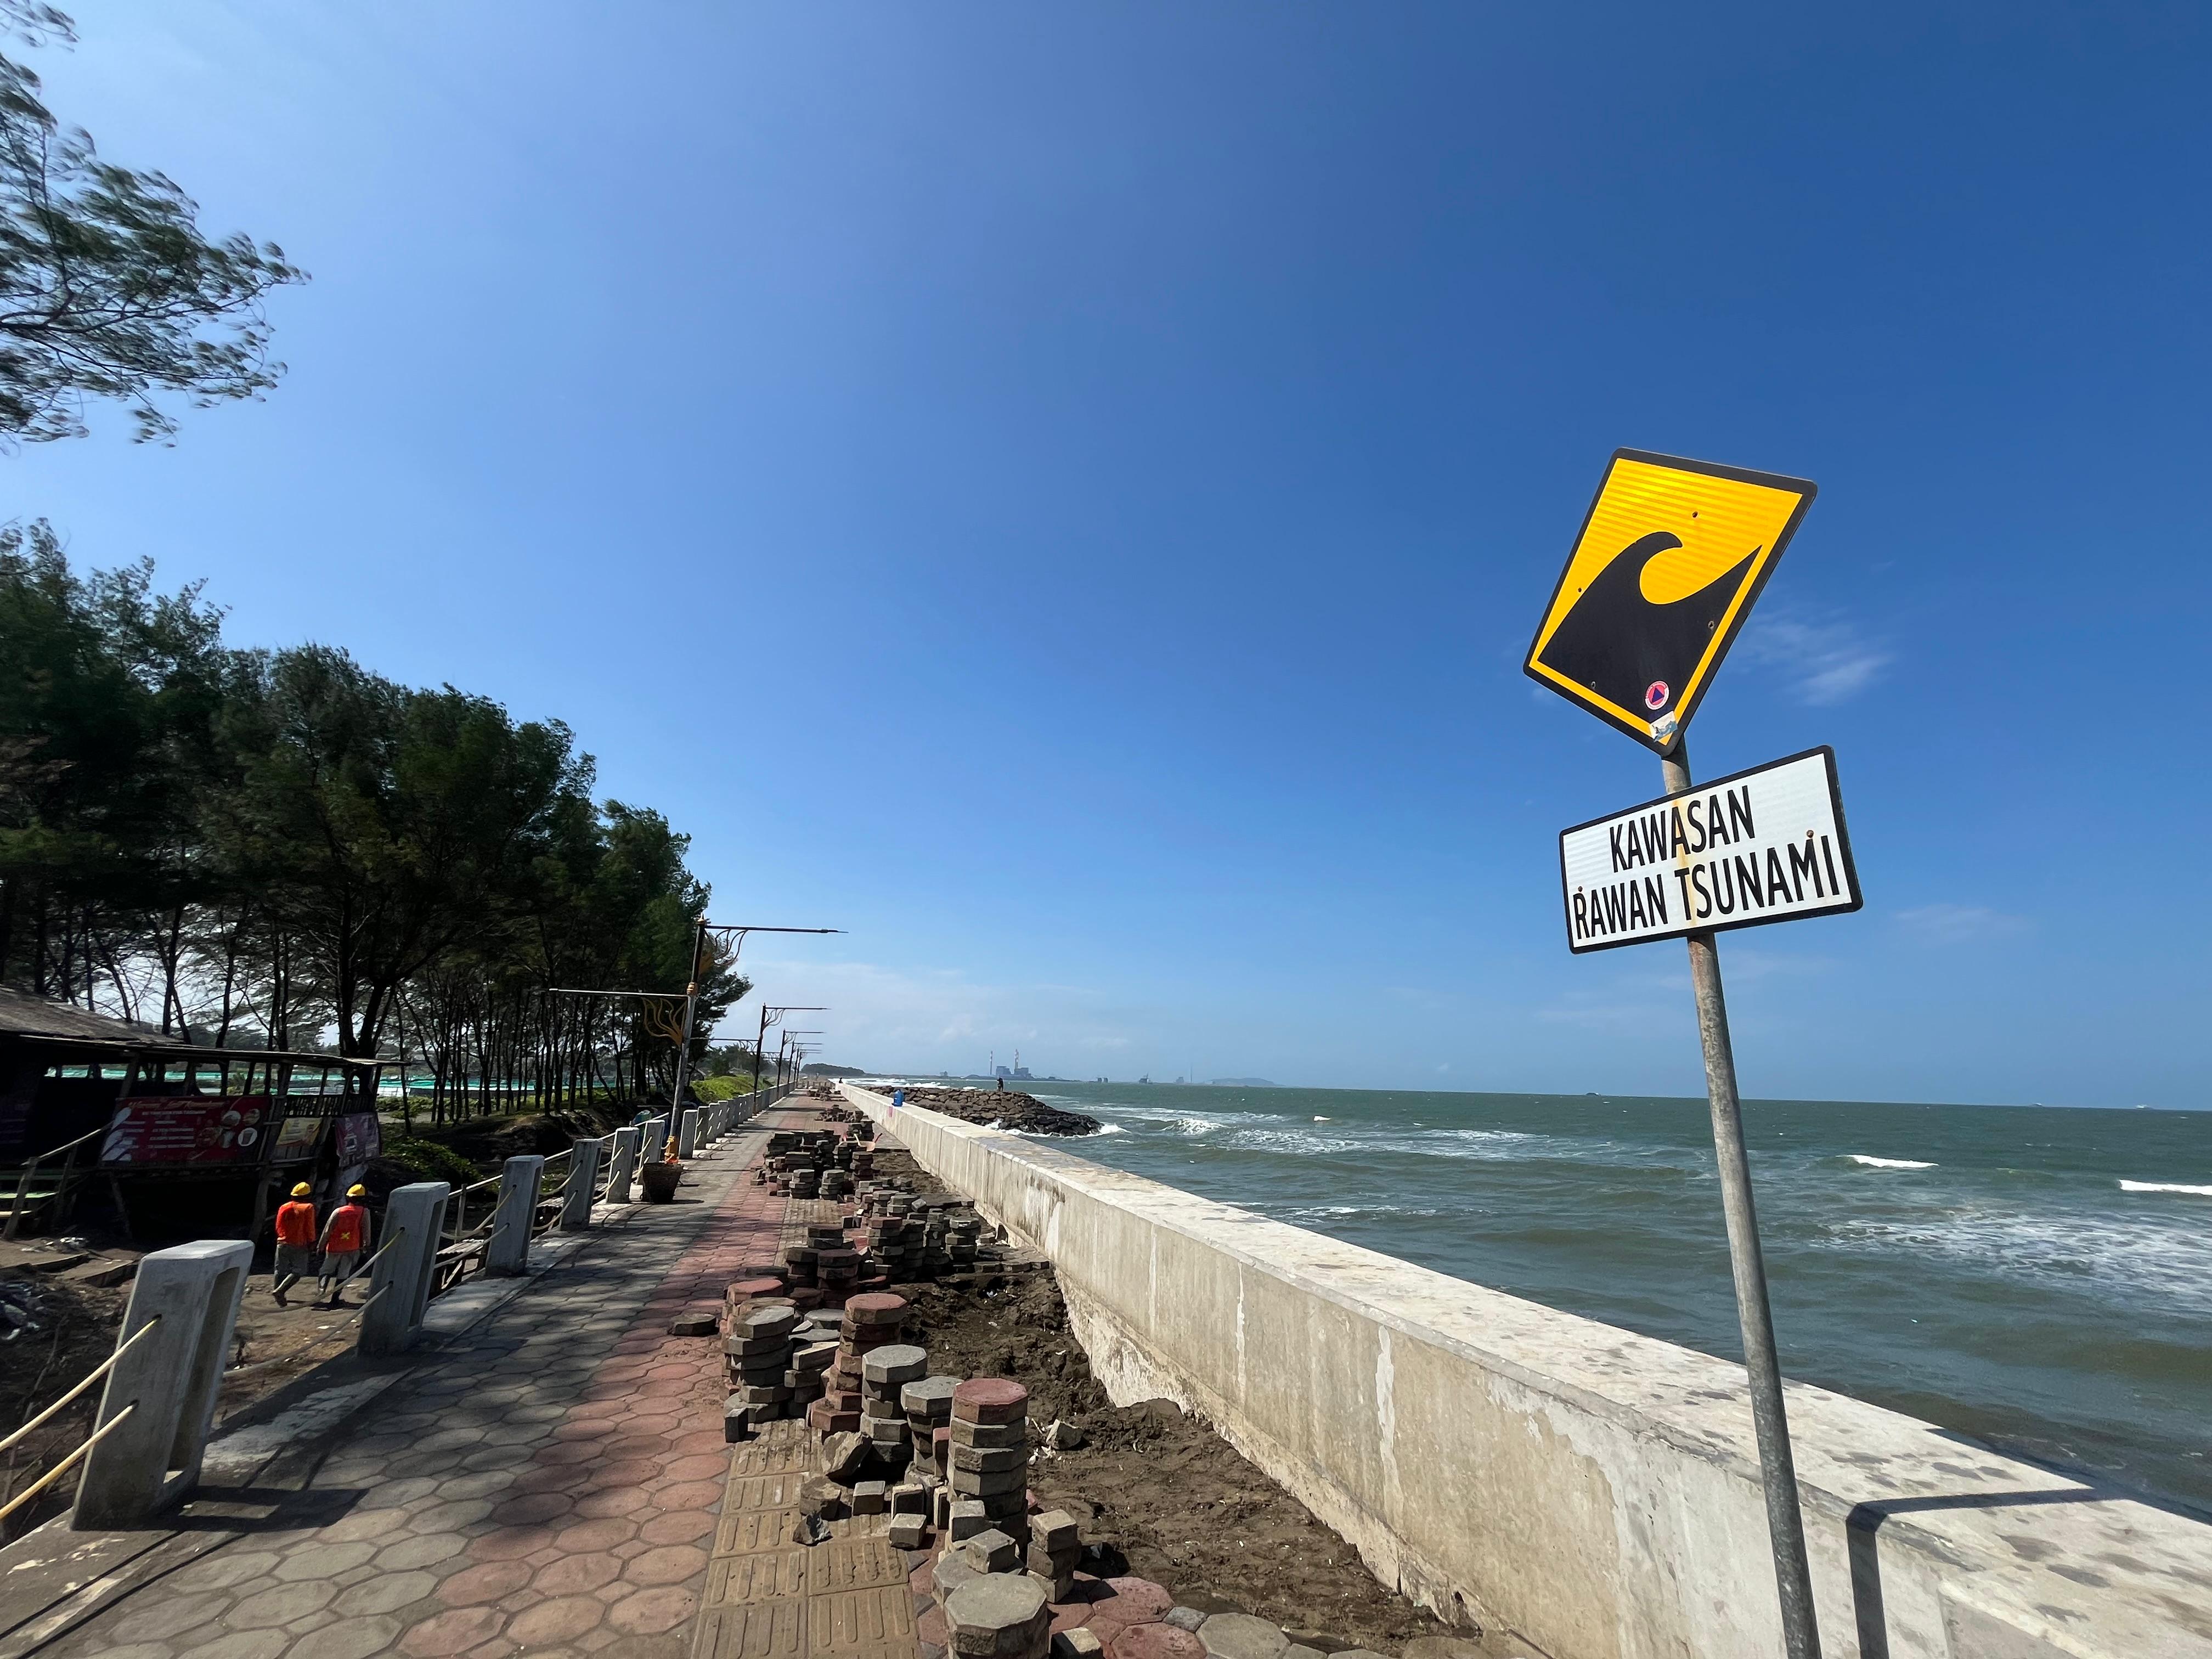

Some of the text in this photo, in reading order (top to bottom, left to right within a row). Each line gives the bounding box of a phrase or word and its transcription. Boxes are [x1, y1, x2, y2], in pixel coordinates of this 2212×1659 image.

[1610, 786, 1755, 873] KAWASAN
[1573, 836, 1840, 939] RAWAN TSUNAMI
